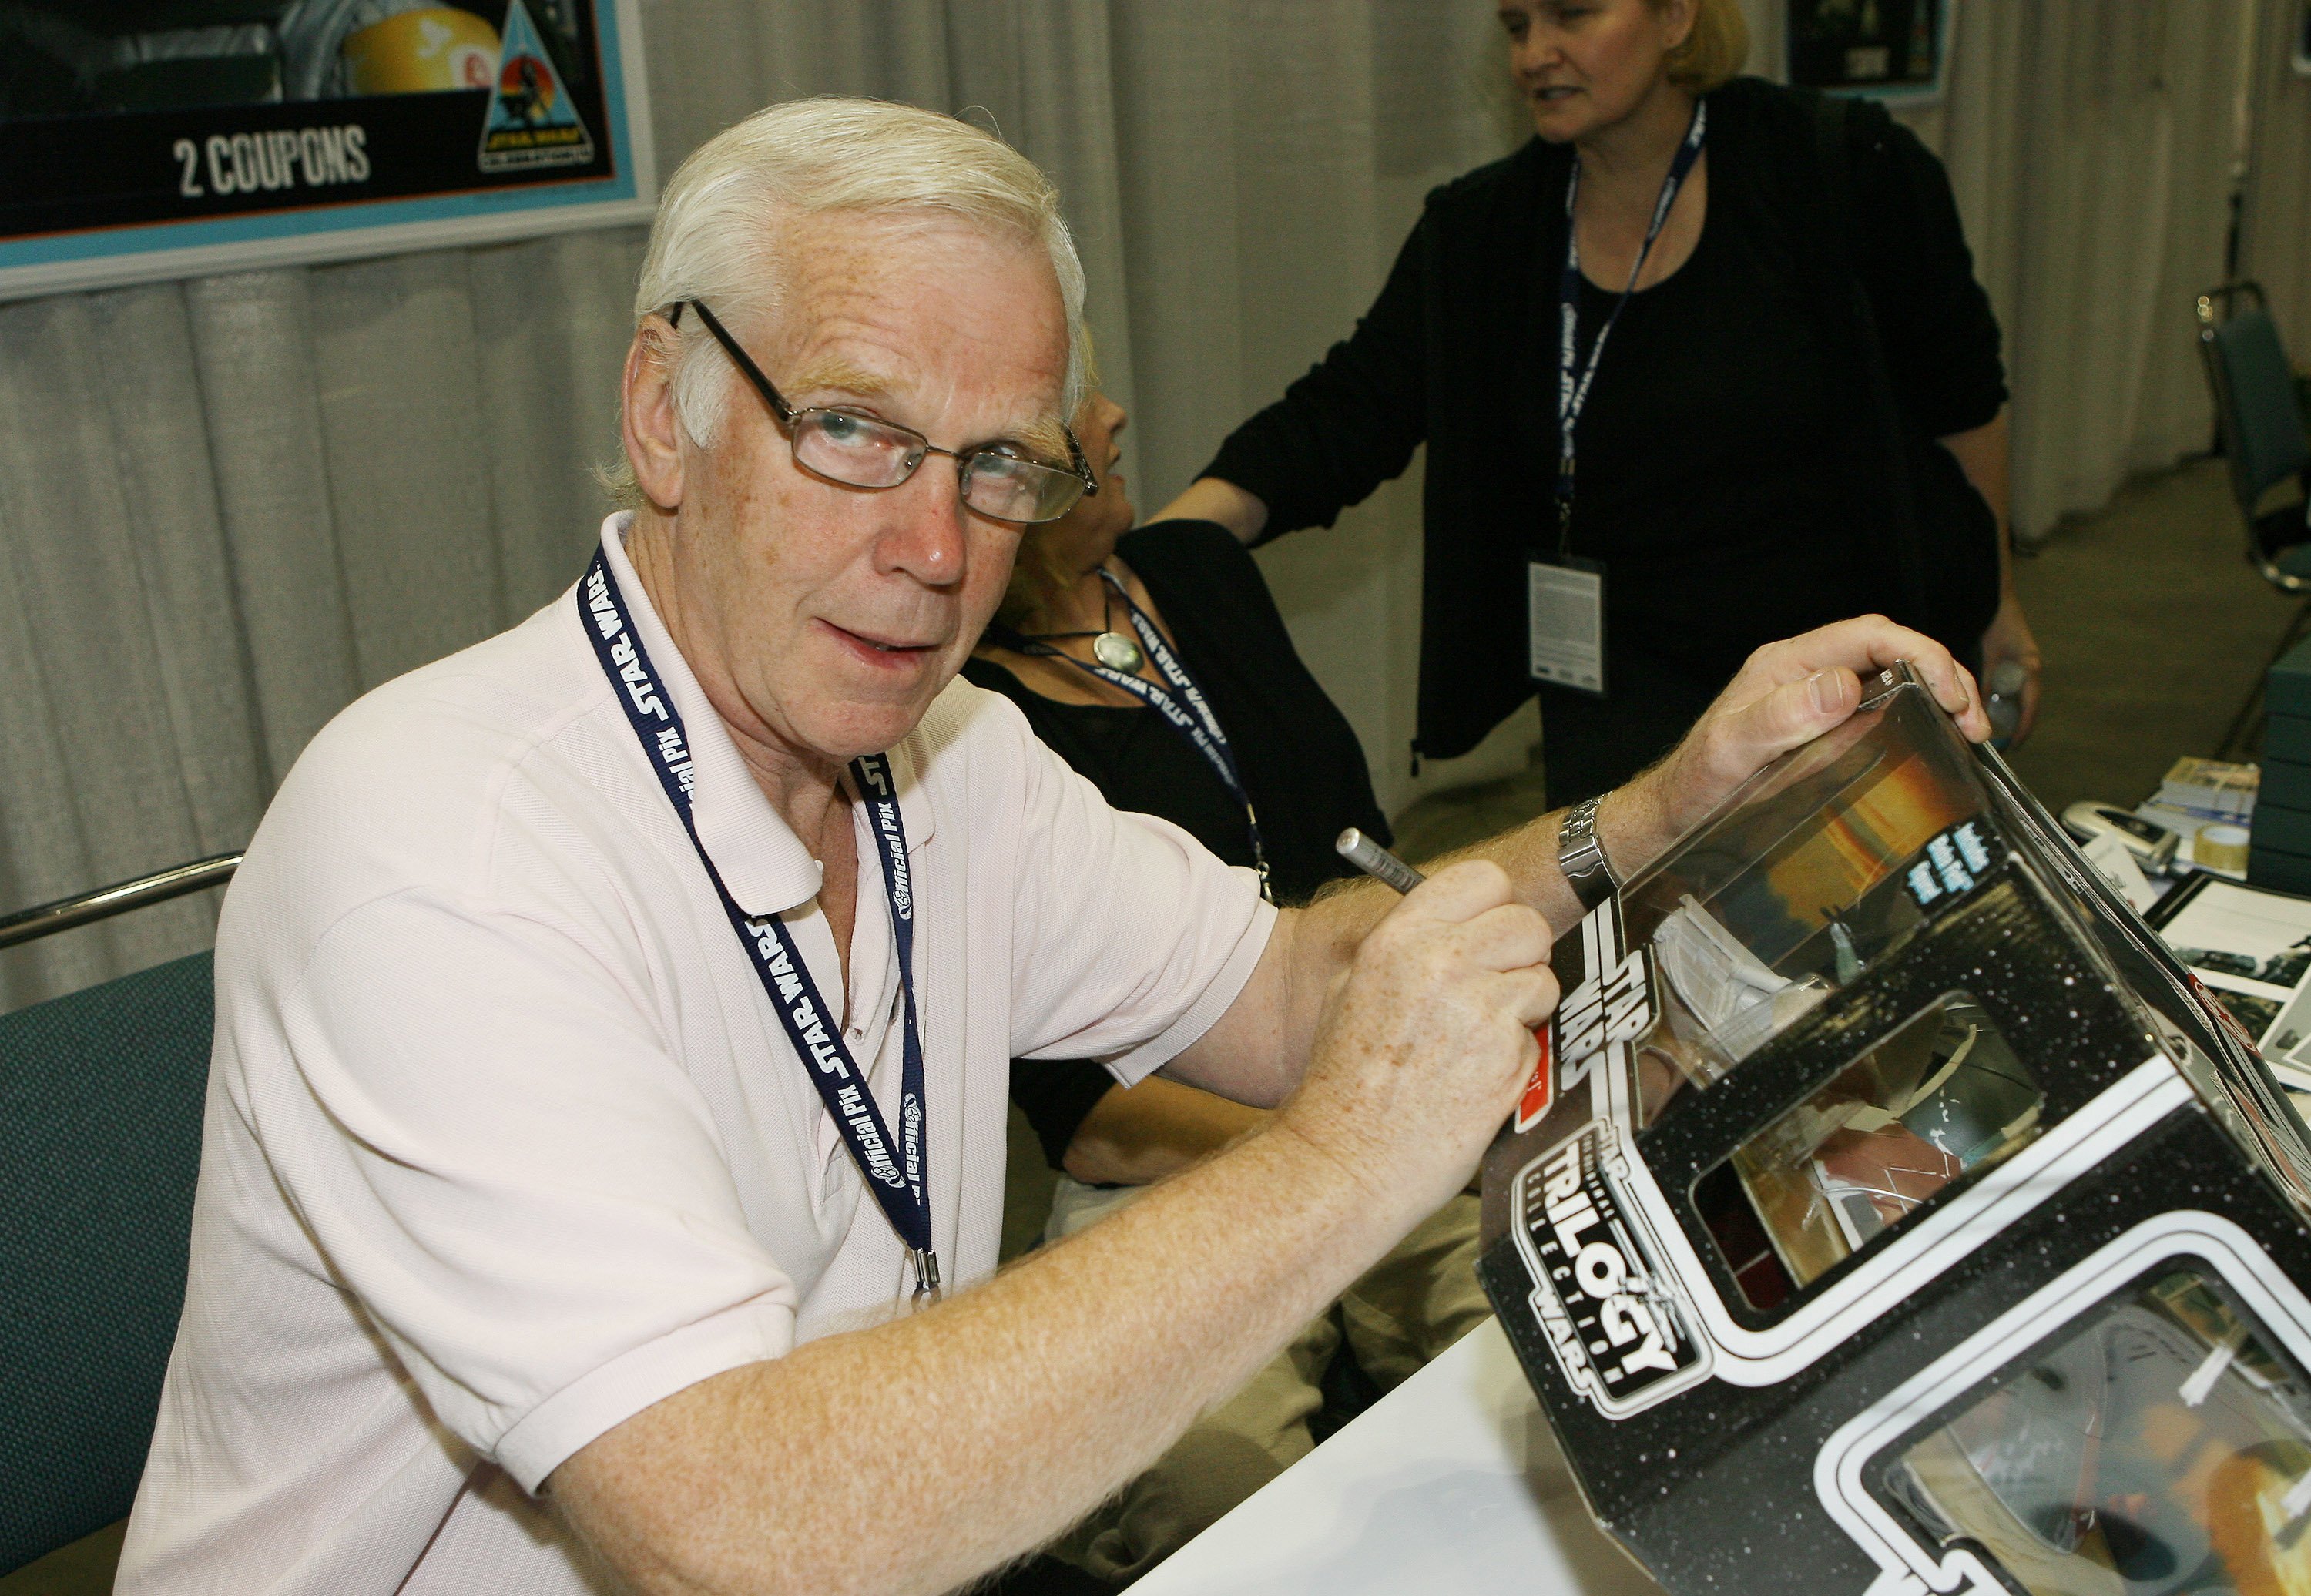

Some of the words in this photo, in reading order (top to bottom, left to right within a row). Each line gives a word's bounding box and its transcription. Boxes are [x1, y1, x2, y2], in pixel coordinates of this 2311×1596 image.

[173, 138, 205, 198] 2
[206, 123, 371, 193] COUPONS
[587, 569, 623, 641] WARS
[610, 632, 669, 721] STAR
[1149, 685, 1195, 726] STAR
[1156, 644, 1192, 687] STAR
[744, 918, 804, 1004] WARS
[1602, 948, 1651, 1043] STAR
[792, 995, 850, 1079] STAR
[1559, 975, 1608, 1091] WARS
[837, 1083, 867, 1117] Pix
[1527, 1172, 1625, 1385] COLLECTION
[1543, 1140, 1678, 1375] TRILOGY
[1535, 1287, 1594, 1388] WARS
